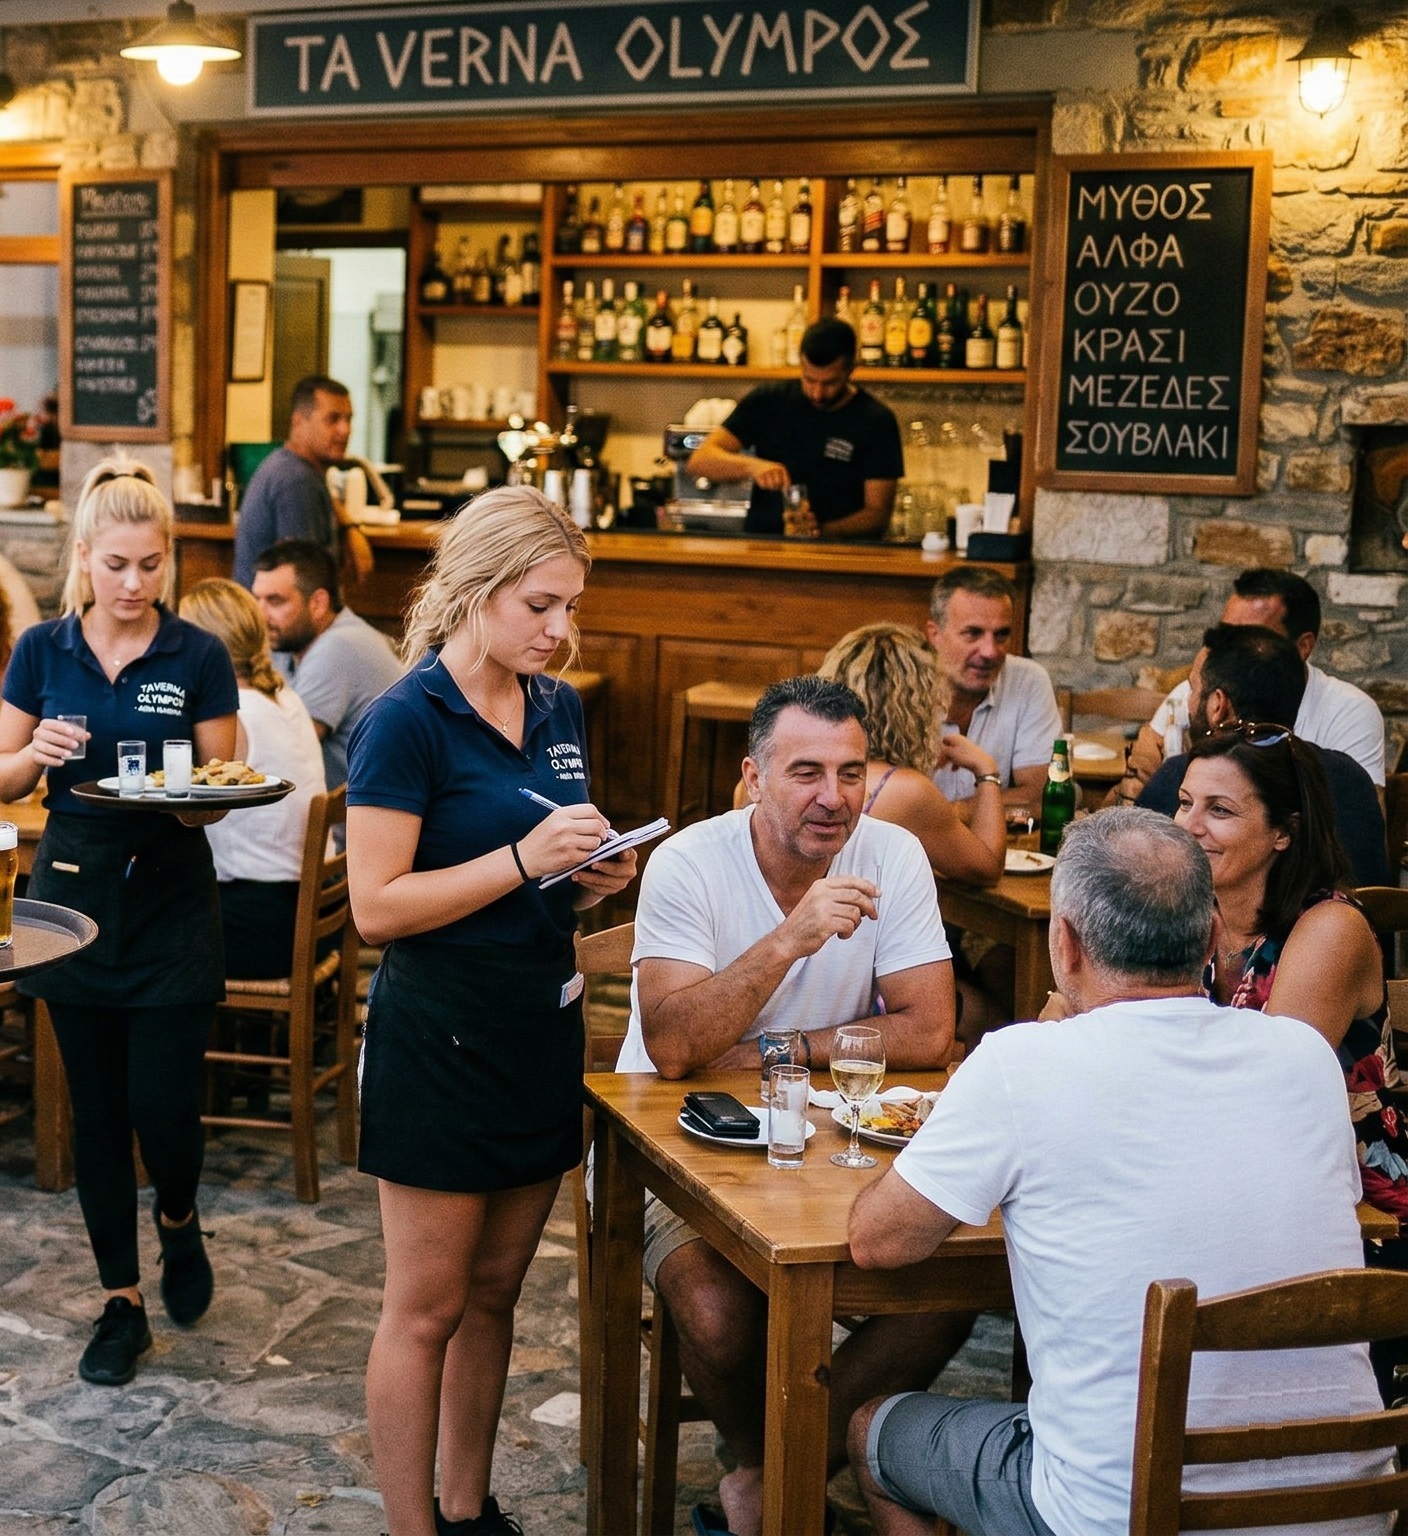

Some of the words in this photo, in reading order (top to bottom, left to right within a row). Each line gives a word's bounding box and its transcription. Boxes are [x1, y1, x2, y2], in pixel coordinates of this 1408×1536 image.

[1077, 183, 1212, 220] ΜΥΘΟΣ
[1076, 232, 1184, 269] ΑΛΦΑ
[1074, 281, 1180, 316] ΟΥΖΟ
[1073, 328, 1185, 363] ΚΡΑΣΙ
[1068, 373, 1230, 411] ΜΕΖΕΔΕΣ
[1065, 420, 1228, 459] ΣΟΥΒΛΑΚΙ
